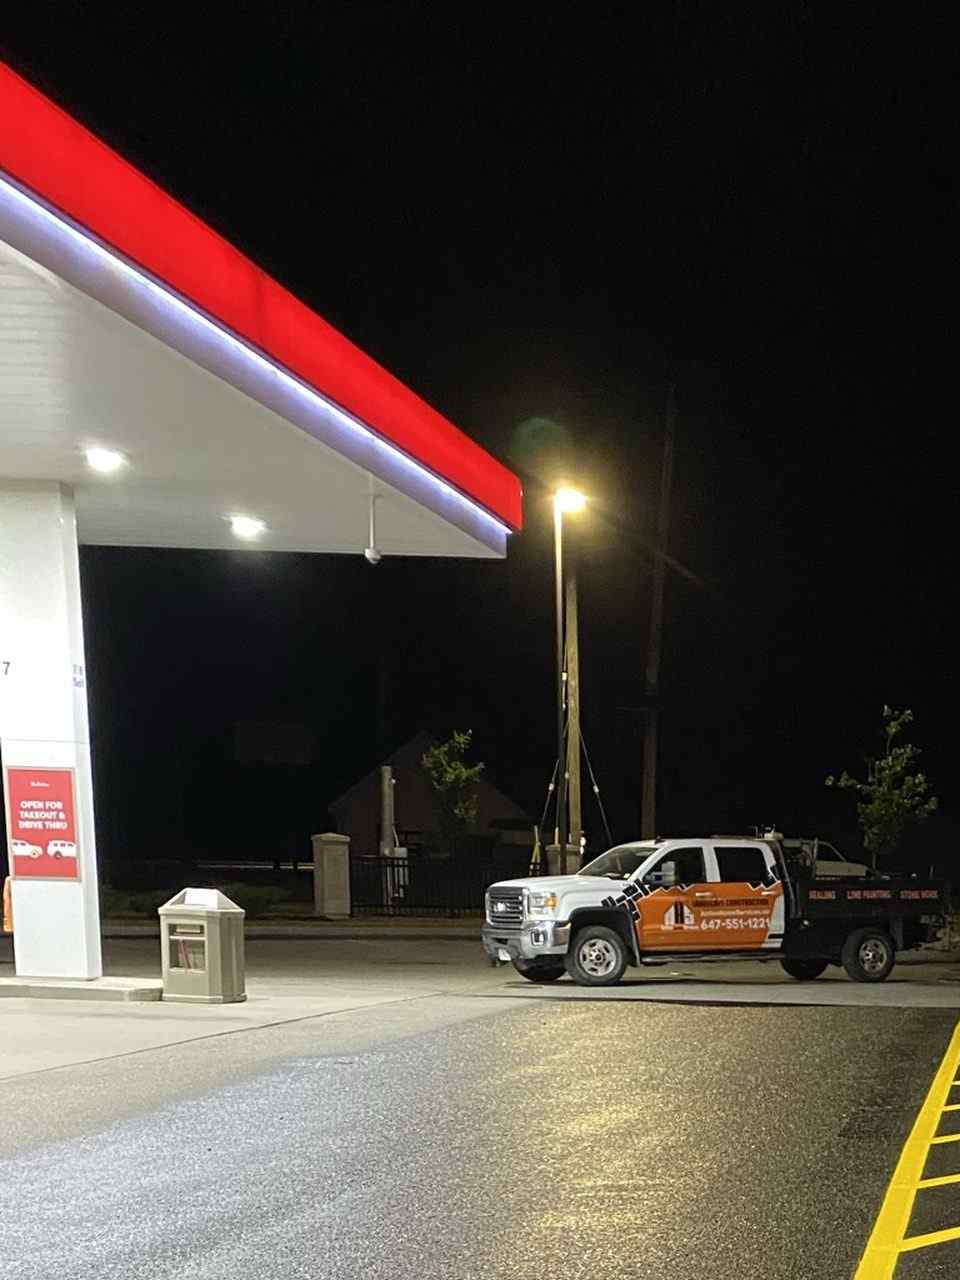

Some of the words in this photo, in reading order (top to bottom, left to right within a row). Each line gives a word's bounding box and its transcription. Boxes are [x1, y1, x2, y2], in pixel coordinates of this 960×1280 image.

[2, 661, 11, 676] 7
[20, 800, 43, 809] OPEN
[45, 800, 63, 809] FOR
[20, 811, 57, 820] TAKEOUT
[18, 820, 43, 829] DRIVE
